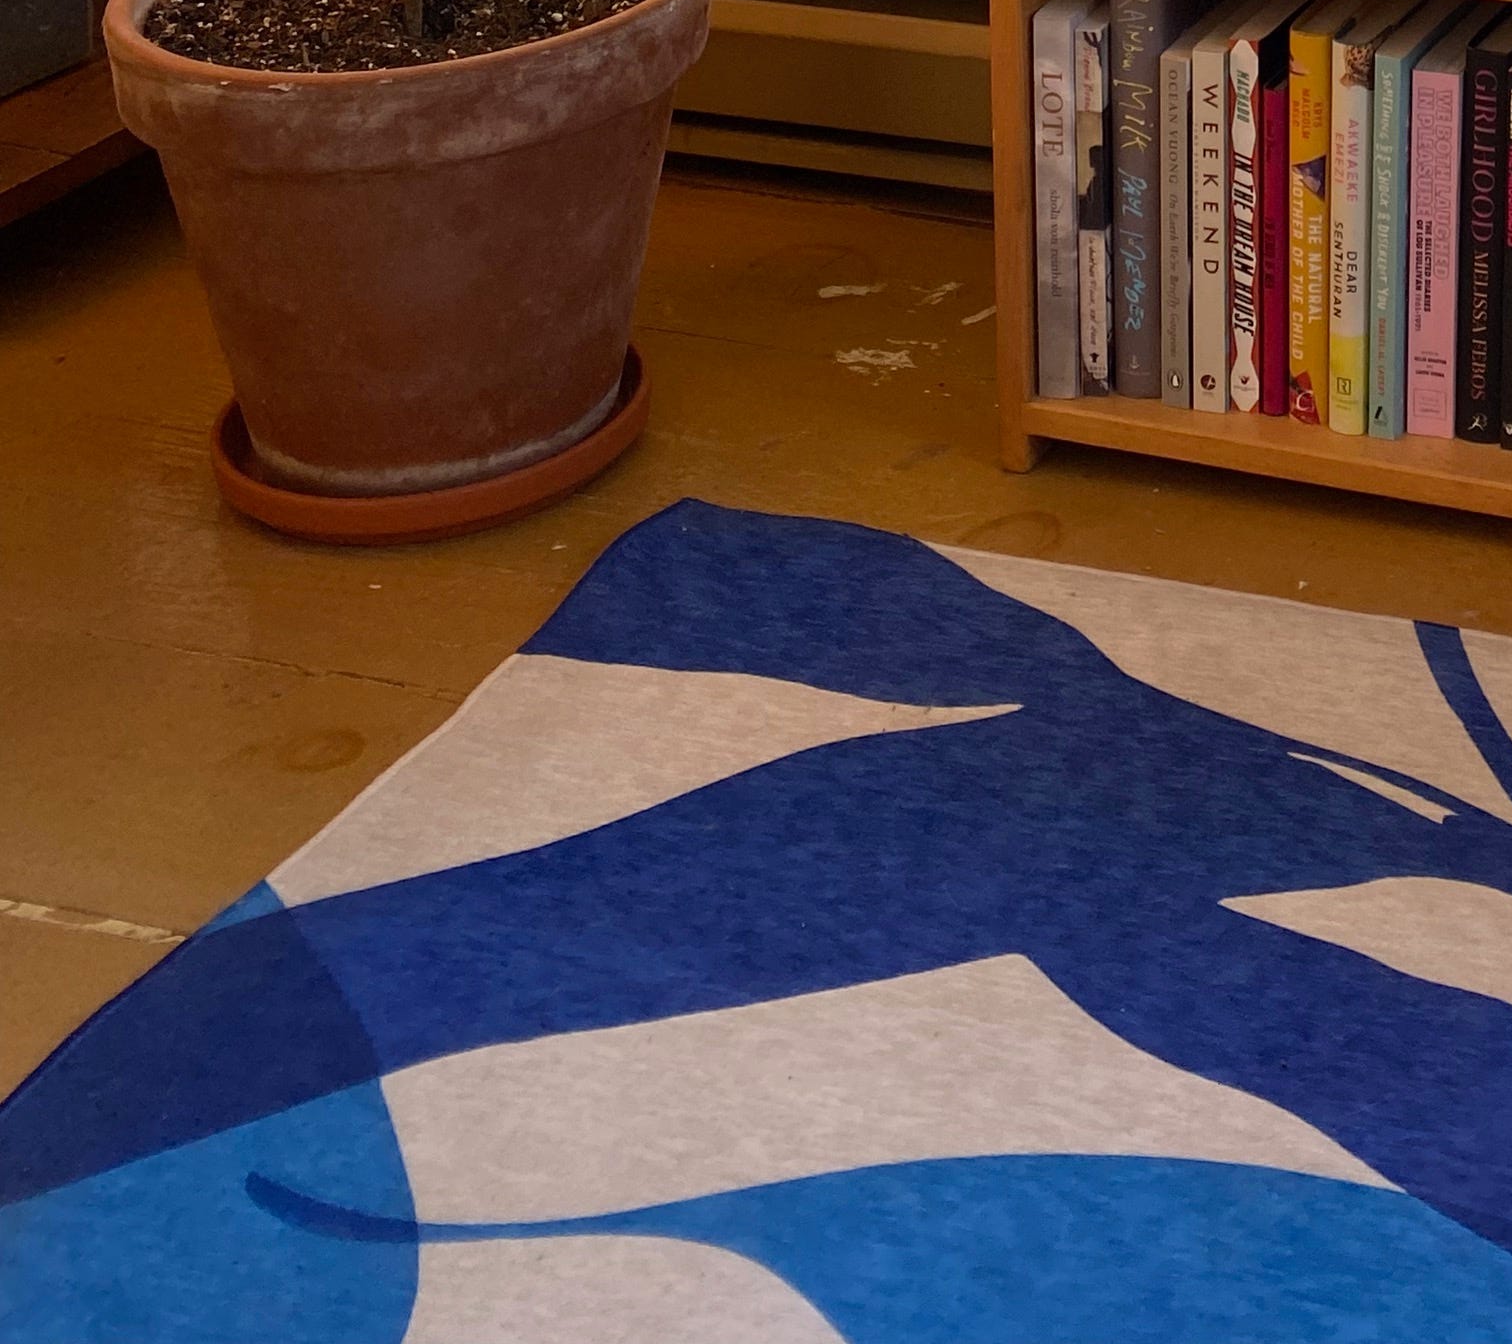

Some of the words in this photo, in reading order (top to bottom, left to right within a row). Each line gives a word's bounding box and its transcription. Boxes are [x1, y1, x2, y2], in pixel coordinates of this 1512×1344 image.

[1041, 71, 1064, 157] LOTE
[1416, 87, 1435, 110] IN
[1436, 89, 1454, 124] WE
[1235, 151, 1253, 174] IN
[1334, 132, 1345, 184] EMEZI
[1346, 119, 1360, 204] AKWAEKE
[1415, 112, 1434, 218] PLEASURE
[1435, 125, 1453, 178] BOTH
[1470, 69, 1497, 243] GIRLHOOD
[1203, 83, 1219, 275] WEEKEND
[1233, 180, 1254, 214] THE
[1291, 171, 1305, 242] MOTHER
[1308, 214, 1323, 246] THE
[1416, 218, 1424, 229] OF
[1425, 219, 1433, 234] THE
[1432, 180, 1452, 281] LAUGHED
[1233, 218, 1255, 278] DREAM
[1292, 247, 1304, 268] OF
[1415, 230, 1424, 249] LOU
[1424, 235, 1433, 277] SELECTED
[1292, 273, 1304, 305] THE
[1308, 252, 1323, 325] NATURAL
[1333, 221, 1344, 319] SENTHURAN
[1346, 250, 1358, 294] DEAR
[1415, 250, 1424, 291] SULLIVAN
[1471, 250, 1489, 333] MELISSA
[1233, 279, 1254, 337] HOUSE
[1423, 279, 1432, 312] DIARIES
[1291, 311, 1304, 360] CHILD
[1470, 338, 1488, 400] FEBOS
